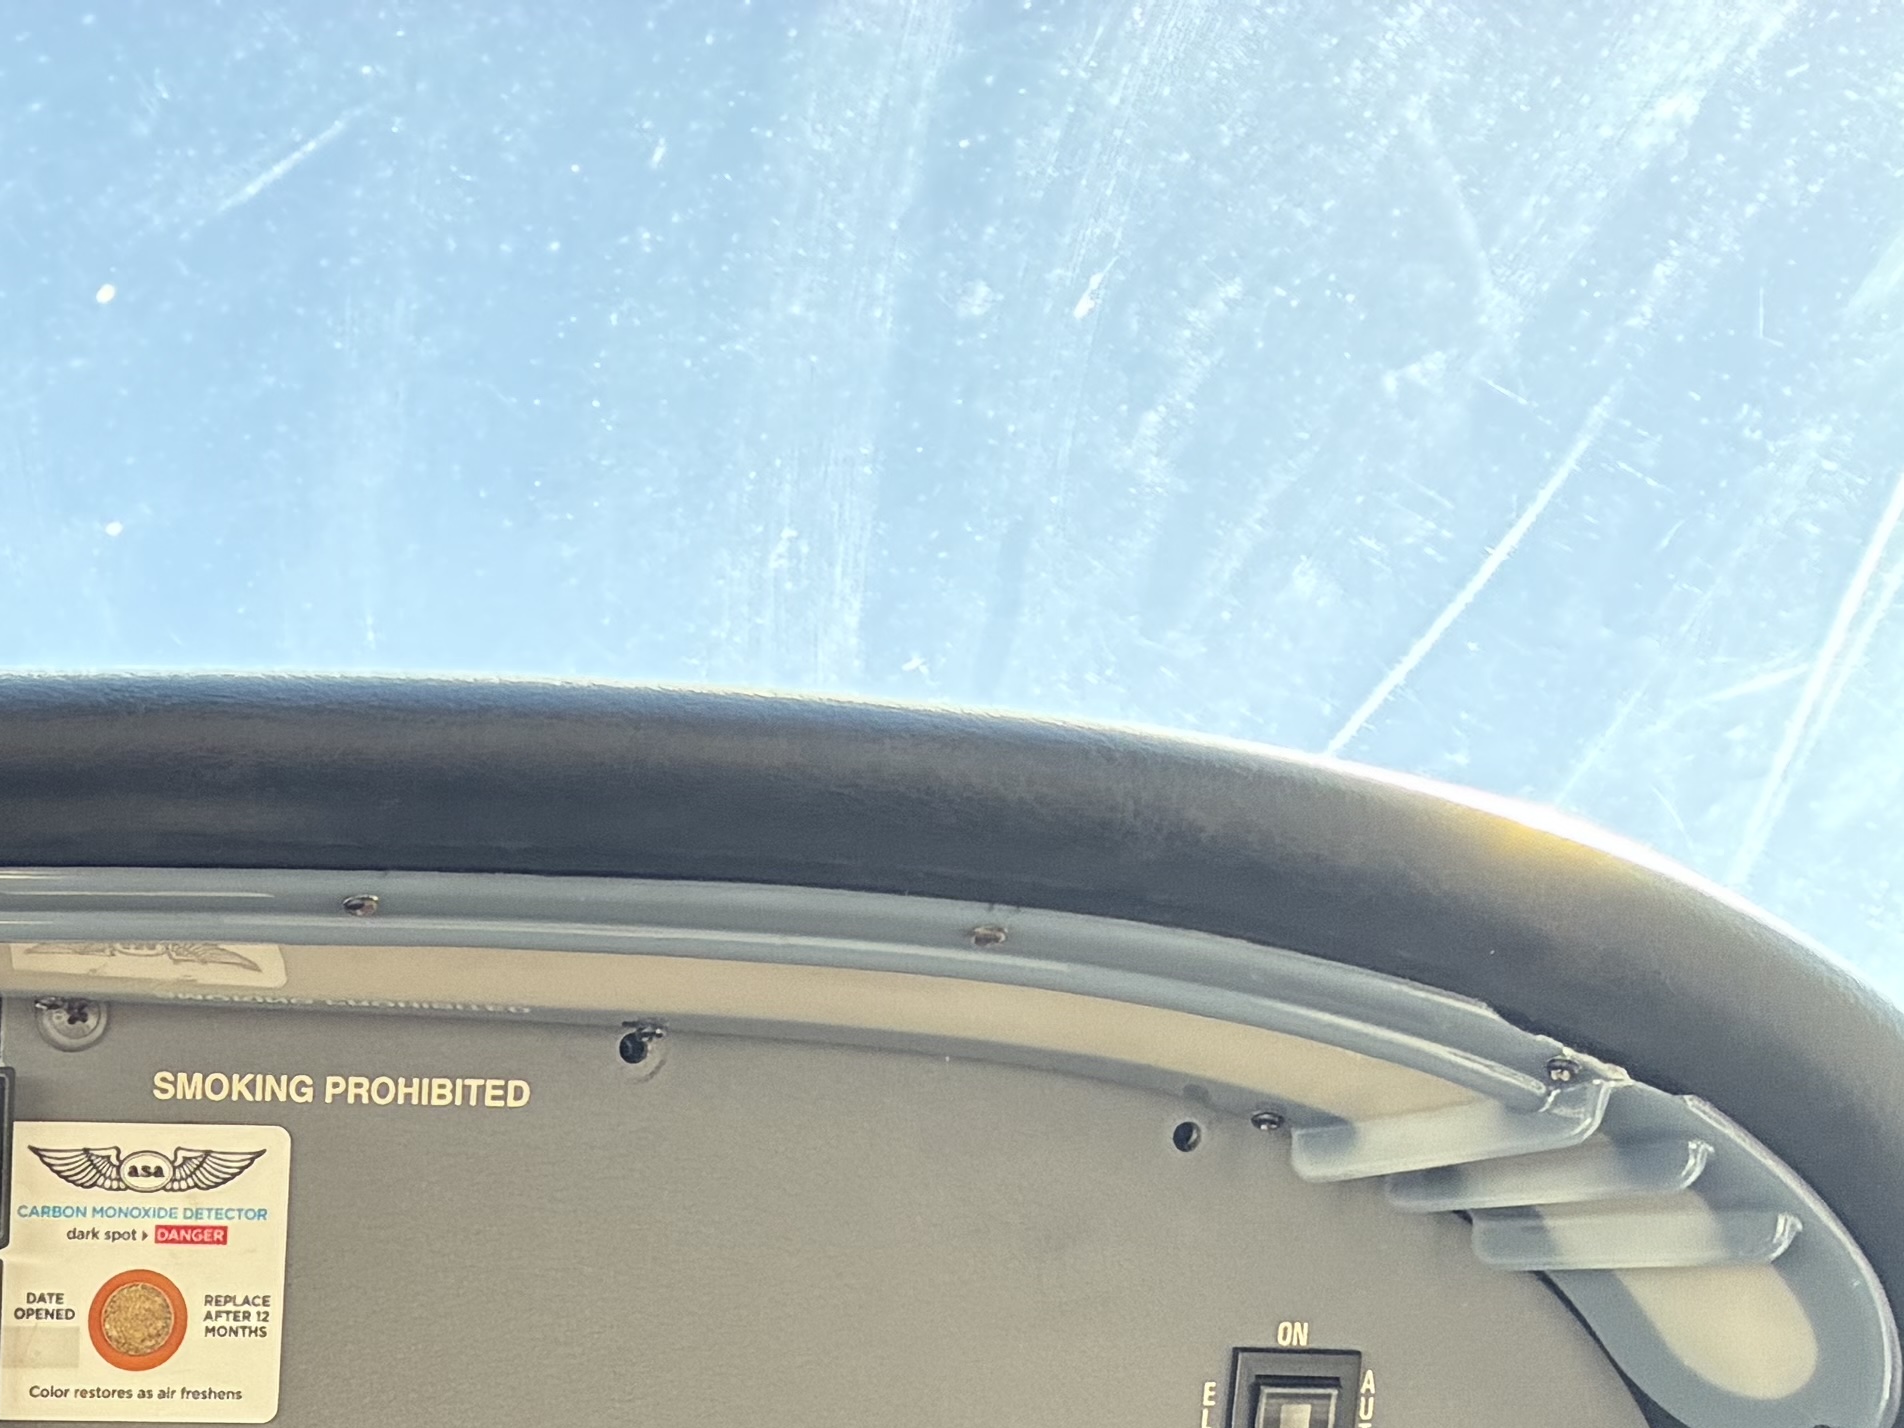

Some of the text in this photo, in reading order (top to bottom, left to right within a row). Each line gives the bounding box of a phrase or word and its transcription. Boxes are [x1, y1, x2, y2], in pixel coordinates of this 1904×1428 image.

[152, 1070, 531, 1108] SMOKING PROHIBITED
[127, 1164, 166, 1179] asa
[16, 1203, 268, 1223] CARBON MONOXIDE DETECTOR
[65, 1226, 138, 1244] dark spot
[156, 1227, 225, 1243] DANGER
[25, 1291, 65, 1305] DATE
[203, 1293, 272, 1308] REPLACE
[13, 1306, 76, 1321] OPENED
[202, 1309, 270, 1323] AFTER 12
[204, 1324, 268, 1339] MONTHS
[1276, 1321, 1309, 1347] ON
[28, 1384, 243, 1401] Color restores as air freshens
